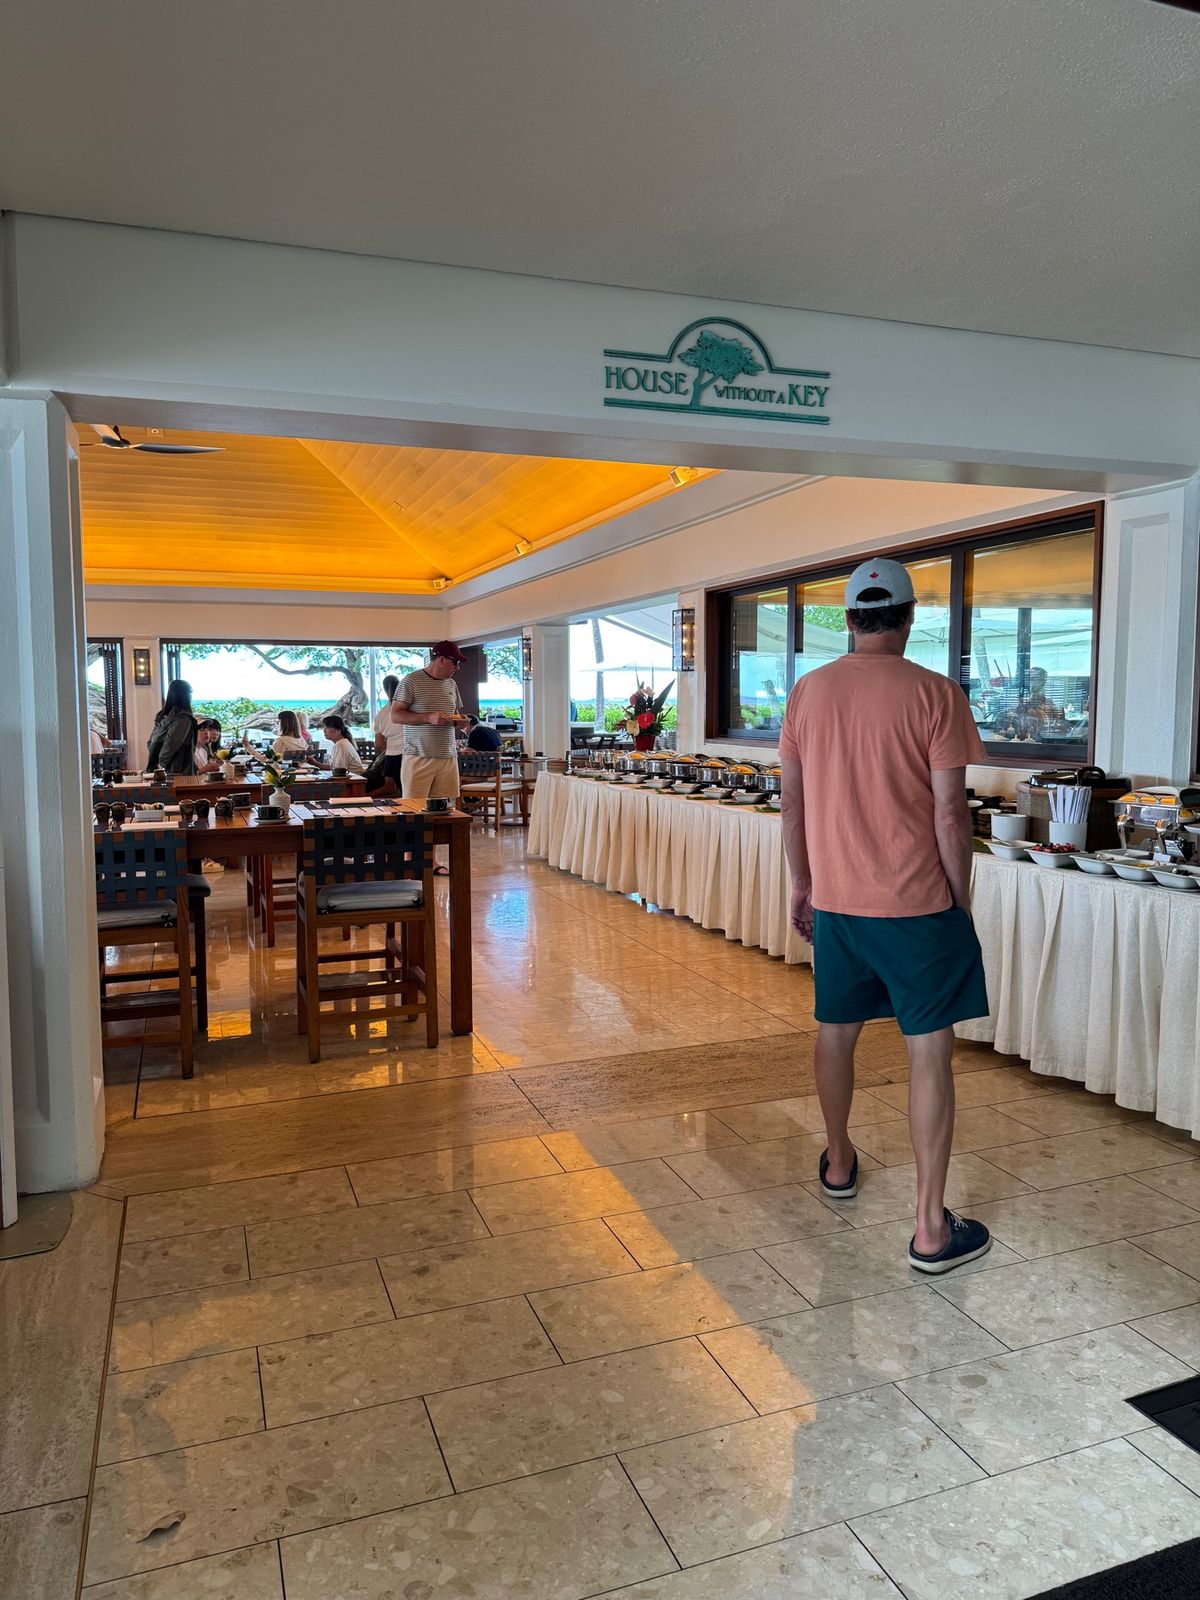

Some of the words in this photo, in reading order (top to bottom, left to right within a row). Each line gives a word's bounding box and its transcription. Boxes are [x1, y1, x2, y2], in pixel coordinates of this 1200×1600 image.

[604, 366, 689, 396] HOUSE
[714, 385, 775, 403] WITHOUT
[775, 393, 785, 404] A
[788, 383, 830, 407] KEY
